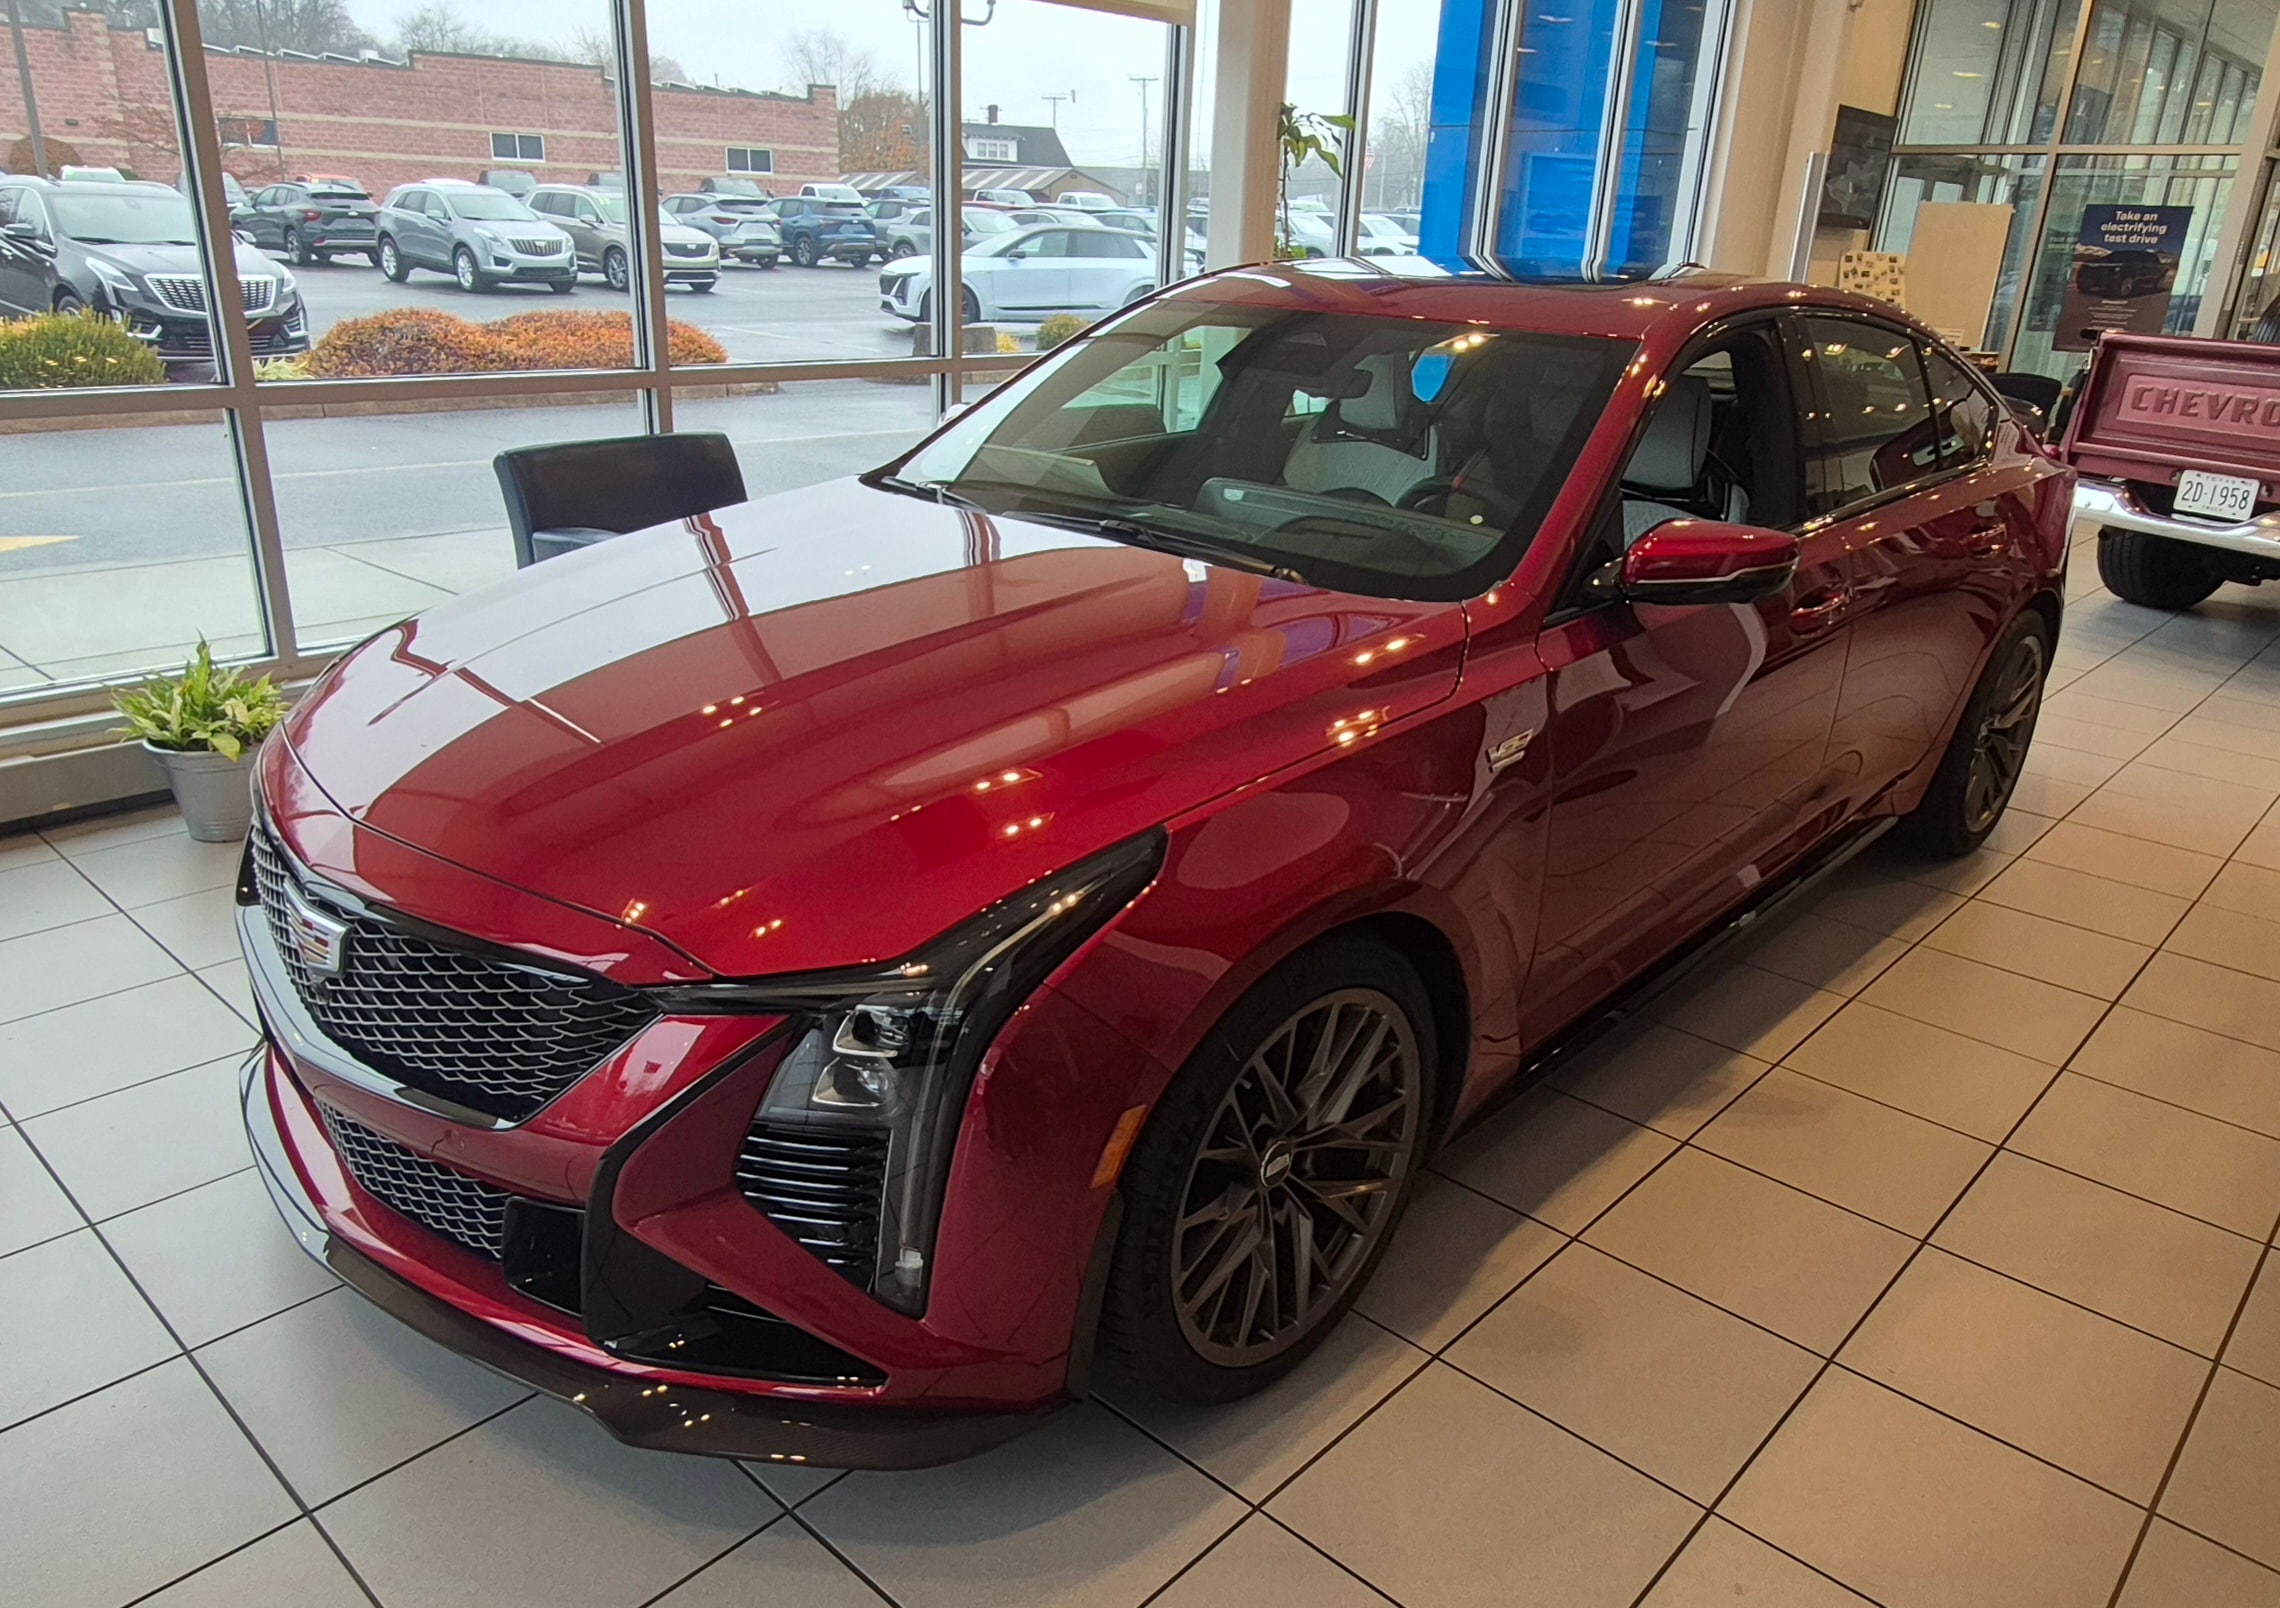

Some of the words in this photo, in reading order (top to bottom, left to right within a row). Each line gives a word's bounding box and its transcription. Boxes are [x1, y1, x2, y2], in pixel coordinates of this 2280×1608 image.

[2115, 210, 2141, 221] Take
[2142, 213, 2159, 221] an
[2100, 222, 2168, 235] electrifying
[2104, 233, 2127, 243] test
[2128, 234, 2159, 244] drive
